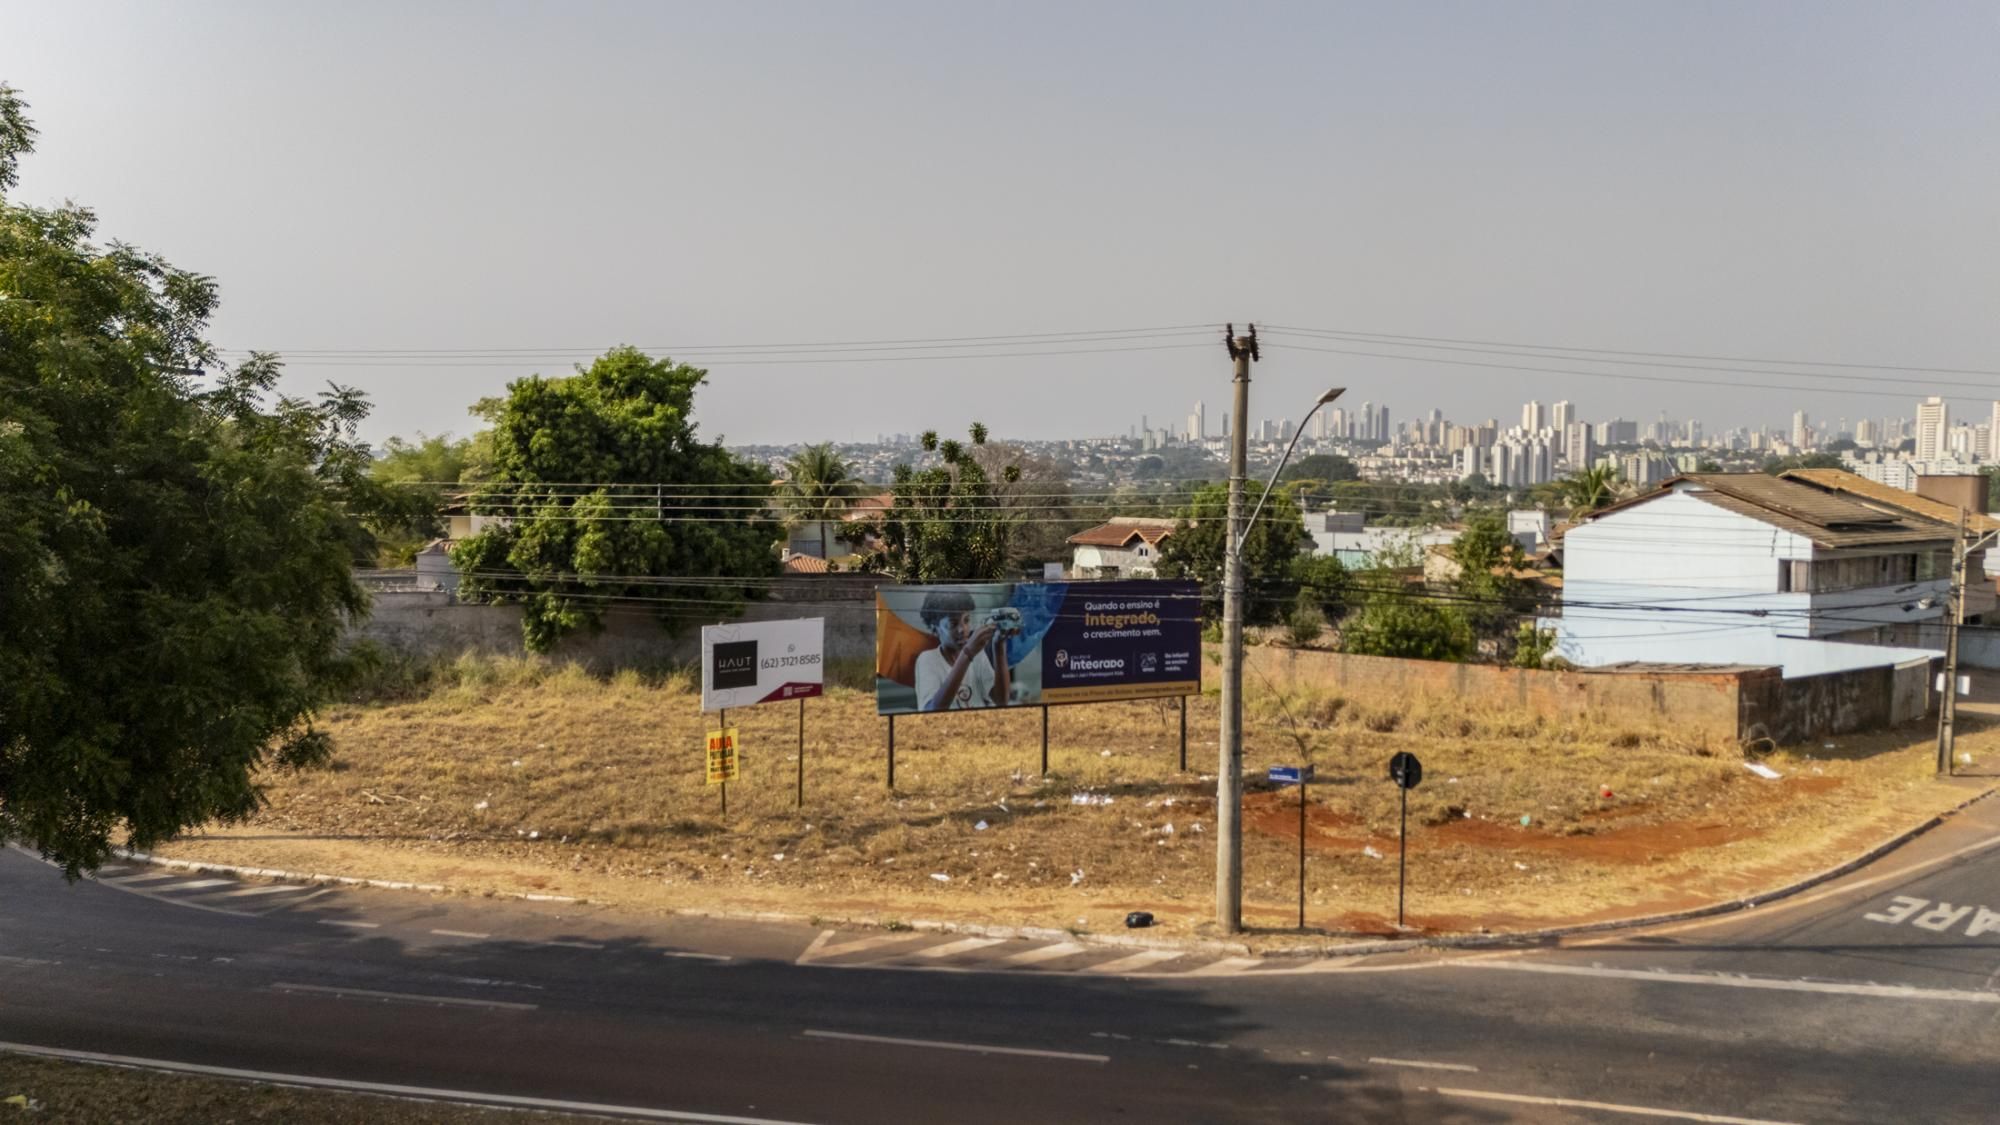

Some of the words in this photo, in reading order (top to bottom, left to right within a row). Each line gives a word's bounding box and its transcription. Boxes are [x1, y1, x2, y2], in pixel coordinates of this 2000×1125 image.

[1085, 601, 1118, 610] Quando
[1127, 601, 1153, 609] ensino
[1154, 600, 1160, 608] é
[1085, 611, 1160, 628] Integrado,
[1090, 629, 1141, 638] crescimento
[761, 658, 778, 670] (62)
[781, 656, 798, 667] 3121
[800, 654, 820, 664] 8585
[1863, 896, 2000, 937] ARE
